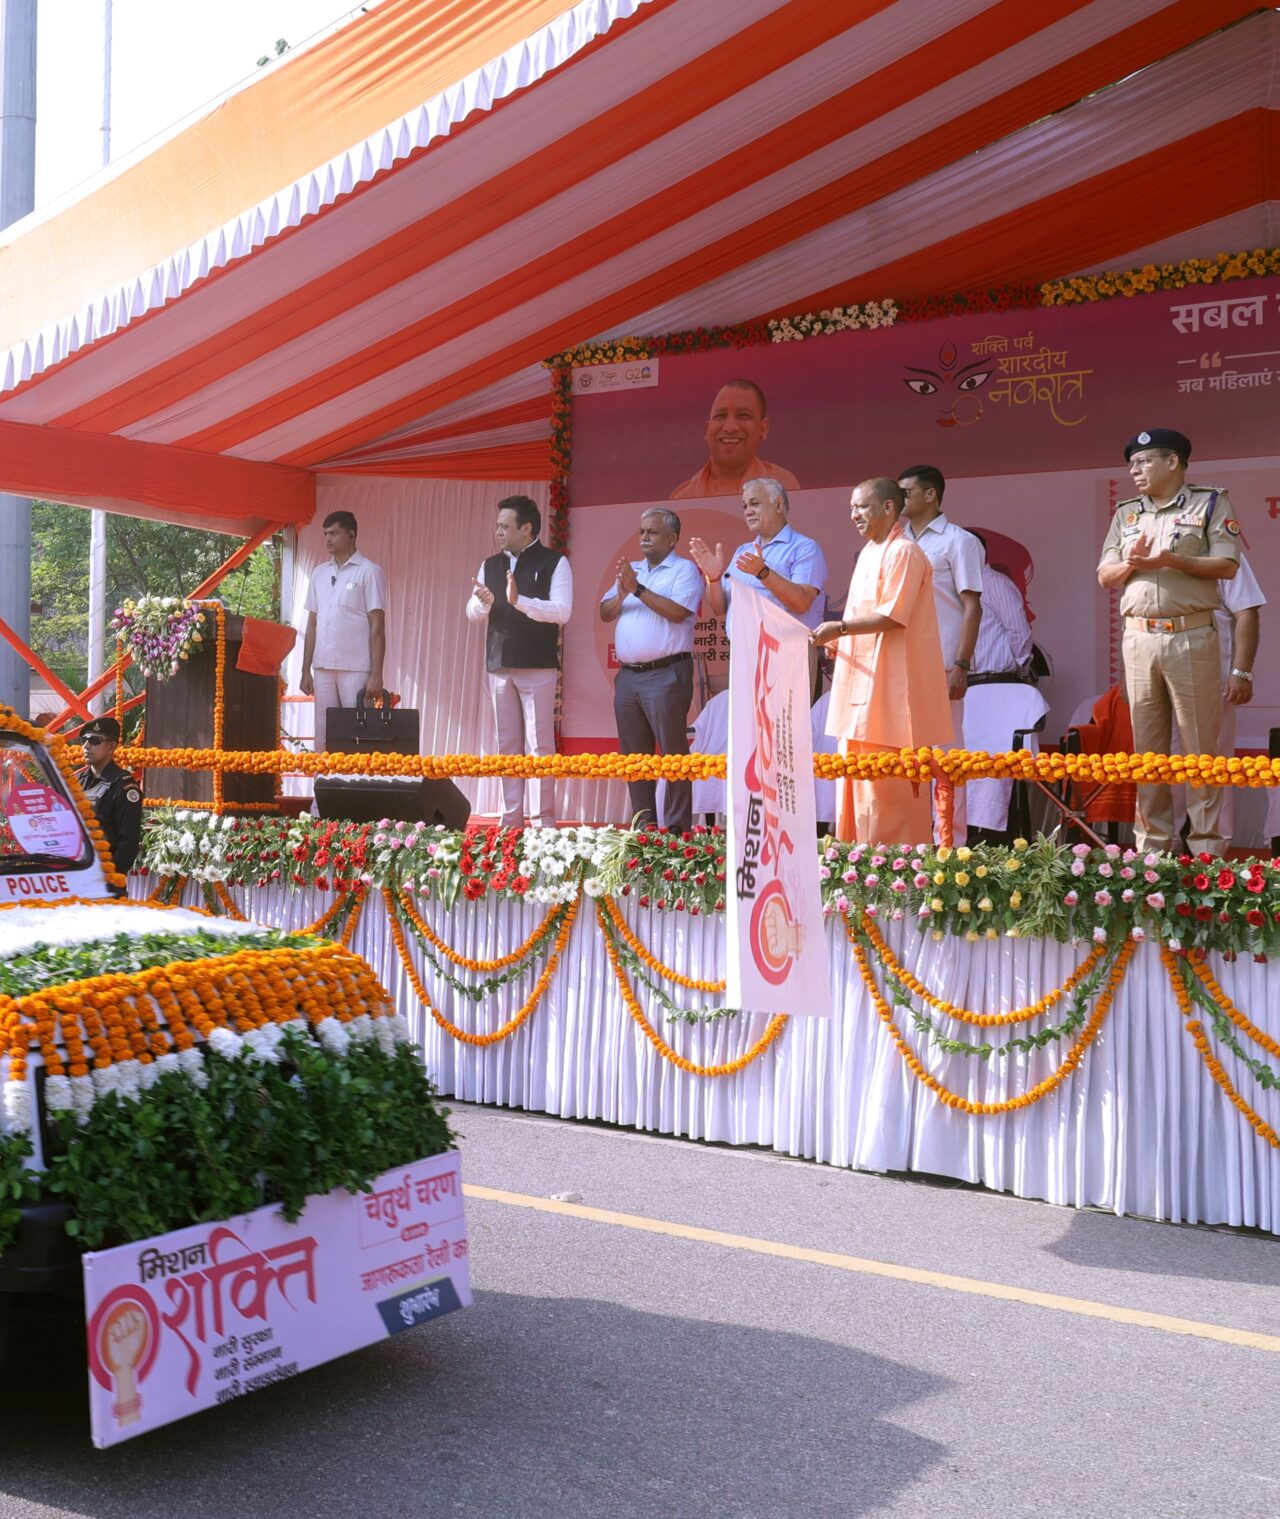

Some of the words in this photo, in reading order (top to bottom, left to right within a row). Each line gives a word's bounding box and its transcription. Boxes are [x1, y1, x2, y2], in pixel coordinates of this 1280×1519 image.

[1170, 295, 1268, 334] सबल
[971, 335, 1009, 355] शक्ति
[1014, 331, 1035, 350] पर्व
[997, 347, 1068, 374] शारदीय
[1177, 378, 1205, 393] जब
[1208, 367, 1274, 390] महिलाएं
[988, 369, 1094, 426] नवरात्र
[694, 618, 717, 631] नारी
[694, 633, 717, 646] नारी
[736, 793, 763, 901] मिशन
[6, 875, 70, 895] POLICE
[364, 1174, 412, 1229] चतुर्थ
[415, 1170, 457, 1204] चरण
[138, 1243, 208, 1283] मिशन
[162, 1227, 319, 1399] शक्ति
